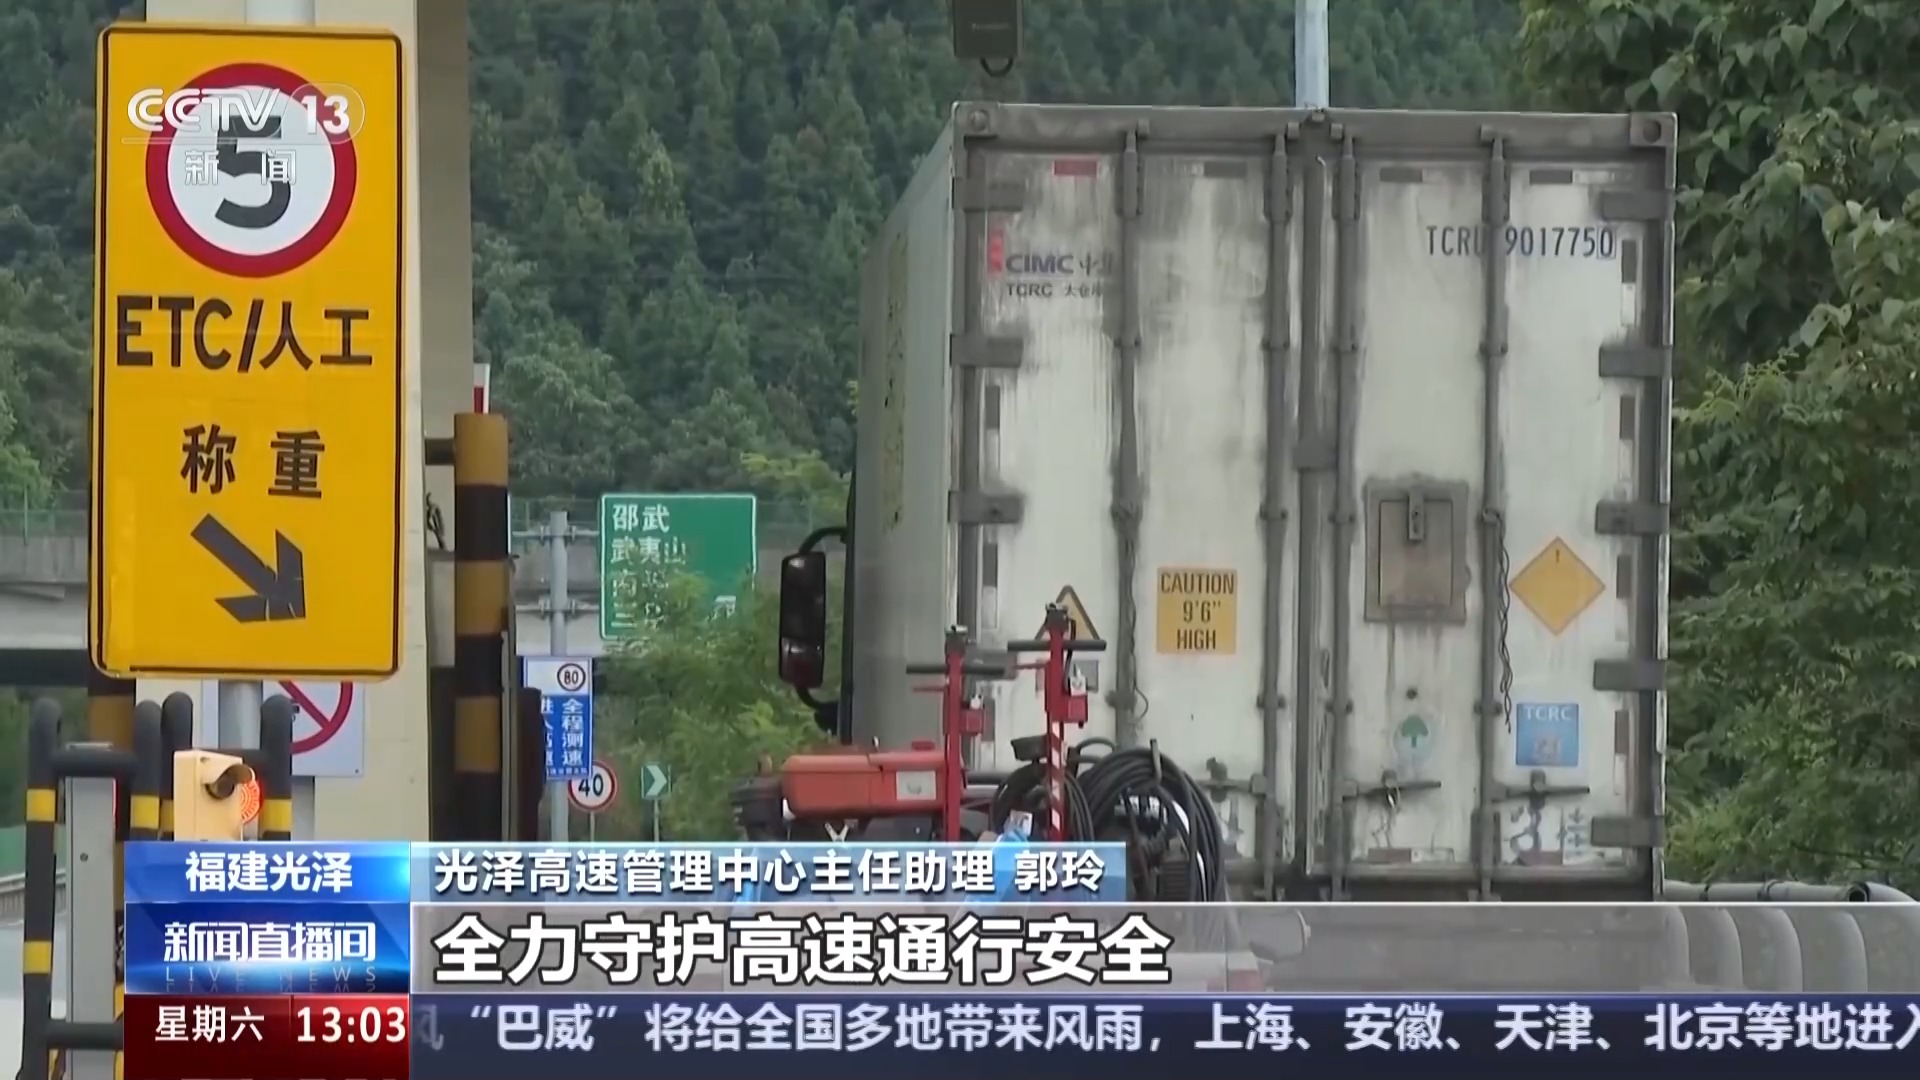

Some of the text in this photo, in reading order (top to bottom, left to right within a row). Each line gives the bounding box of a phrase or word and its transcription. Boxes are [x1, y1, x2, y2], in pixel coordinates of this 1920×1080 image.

[214, 115, 292, 229] 5
[1504, 225, 1616, 259] 9017750
[1006, 254, 1074, 274] CIMC
[116, 294, 373, 374] ETC/人工
[180, 423, 326, 499] 称重
[612, 503, 670, 533] 邵武
[610, 536, 686, 565] 武夷山
[1161, 572, 1234, 594] CAUTION
[1177, 628, 1216, 650] HIGH
[564, 671, 579, 685] 80
[1525, 705, 1572, 720] TCRC
[562, 698, 584, 766] 全程测速
[578, 774, 604, 797] 40
